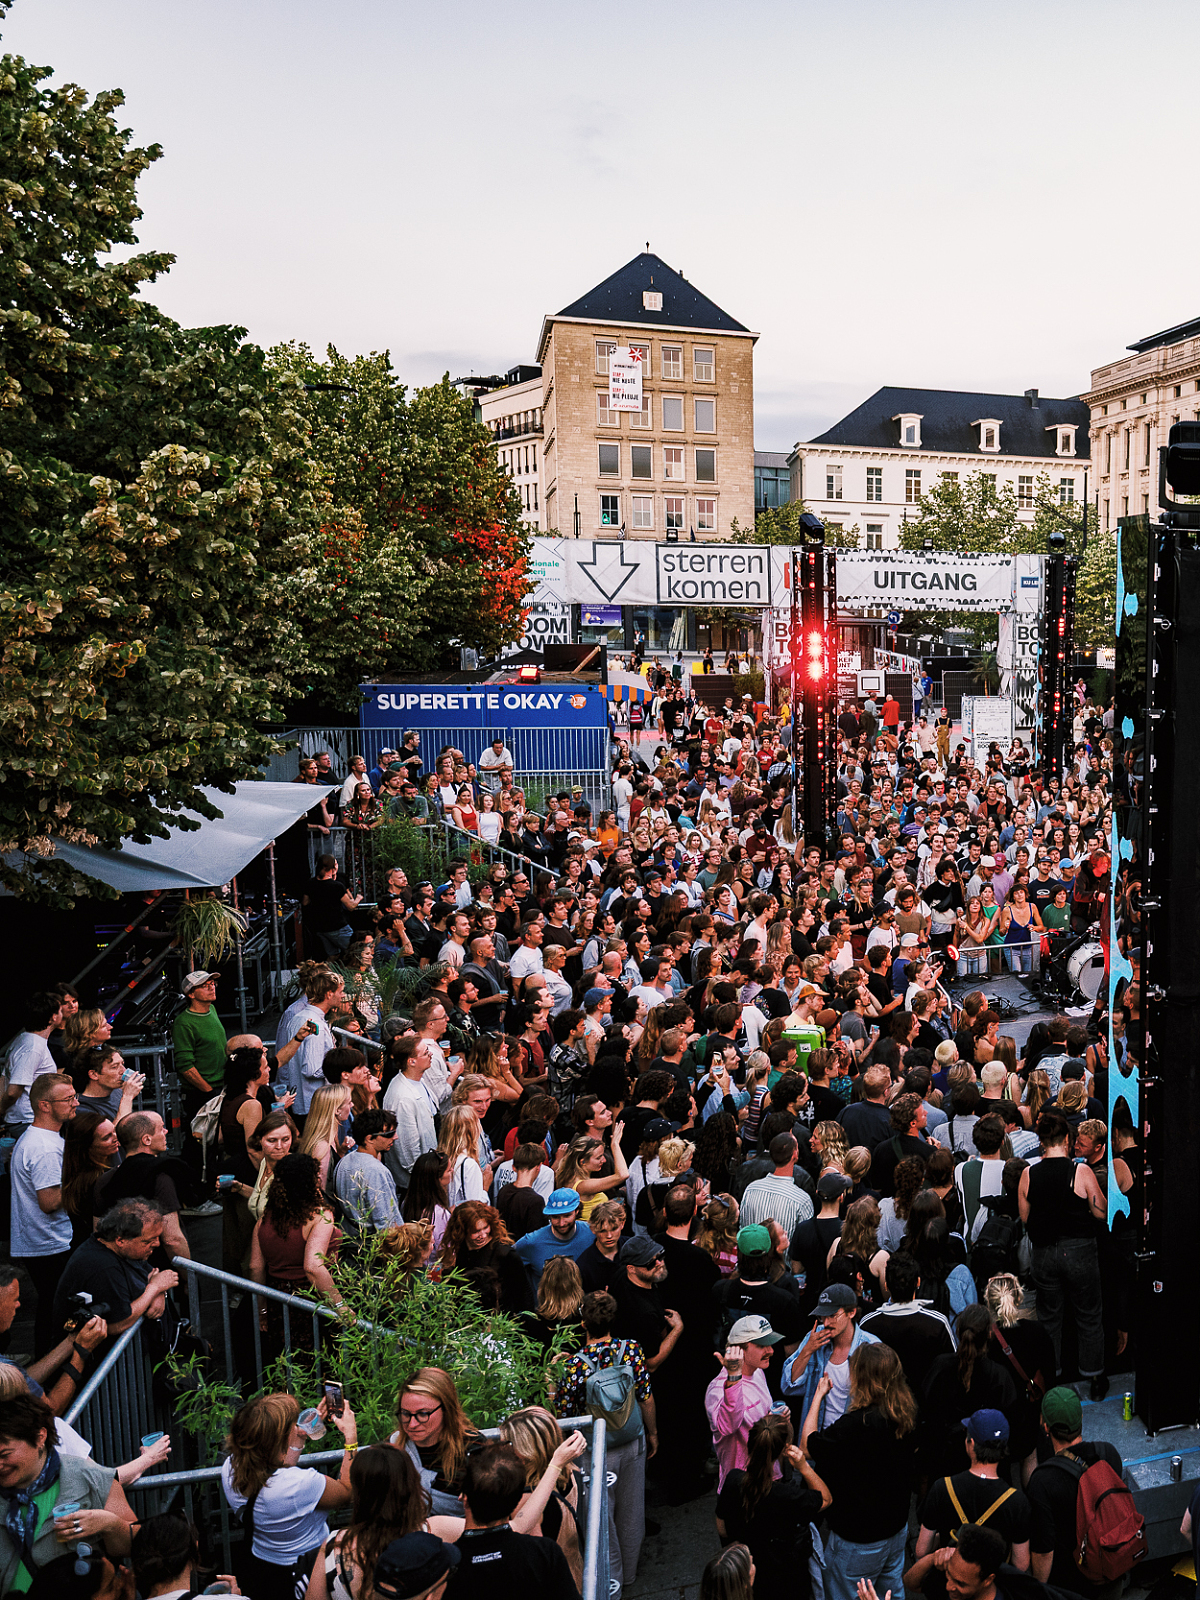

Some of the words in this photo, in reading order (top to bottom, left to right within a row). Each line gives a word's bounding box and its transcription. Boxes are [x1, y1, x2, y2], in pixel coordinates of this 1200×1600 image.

[663, 550, 763, 574] sterren
[667, 575, 761, 599] komen
[873, 570, 977, 591] UITGANG
[377, 693, 500, 710] SUPERETTE
[503, 693, 563, 710] OKAY
